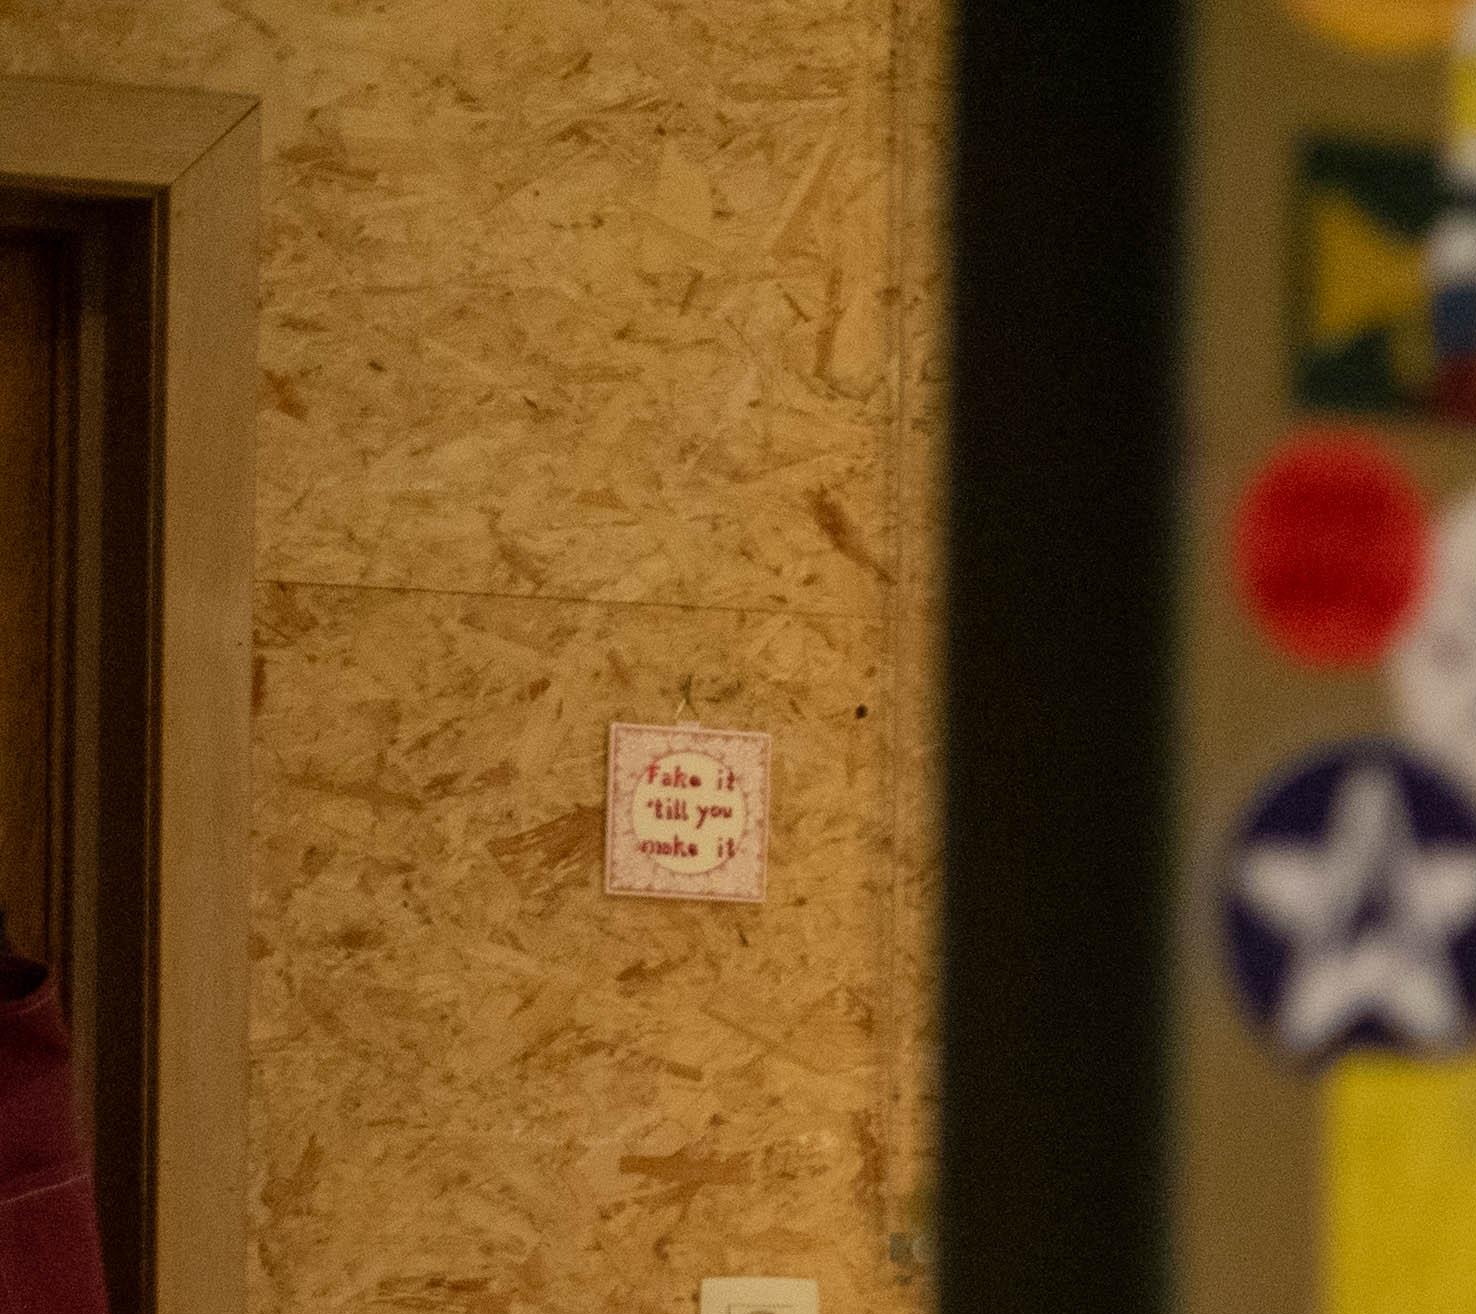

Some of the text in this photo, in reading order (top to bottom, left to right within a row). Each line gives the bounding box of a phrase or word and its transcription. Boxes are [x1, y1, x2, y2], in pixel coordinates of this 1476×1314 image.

[718, 768, 736, 792] it
[695, 805, 733, 830] you
[638, 835, 736, 858] make it
